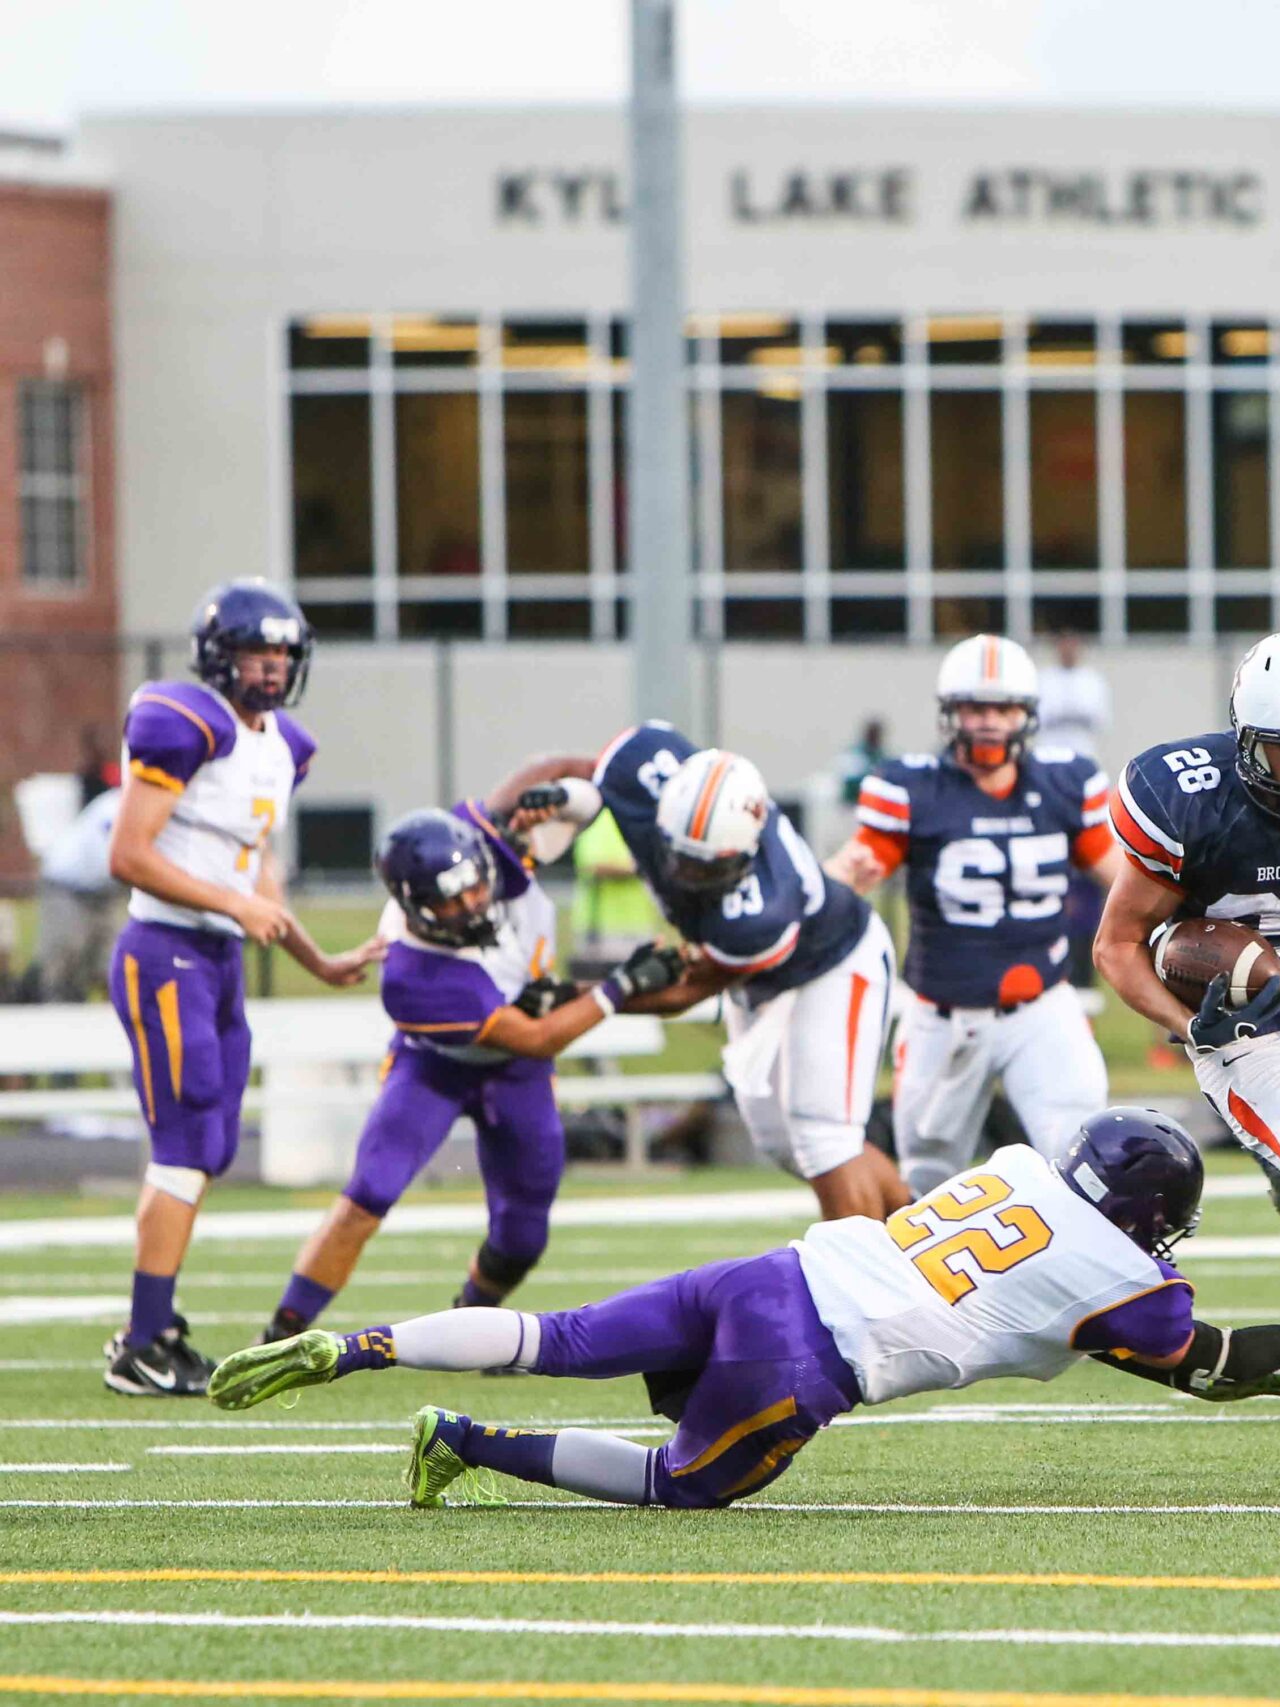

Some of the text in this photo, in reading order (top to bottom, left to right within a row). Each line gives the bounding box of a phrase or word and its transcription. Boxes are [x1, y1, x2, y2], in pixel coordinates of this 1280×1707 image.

[496, 166, 627, 228] KYL
[730, 166, 914, 227] LAKE
[963, 166, 1263, 228] ATHLETIC
[1162, 747, 1221, 794] 28
[934, 831, 1069, 928] 65
[886, 1173, 1054, 1306] 22
